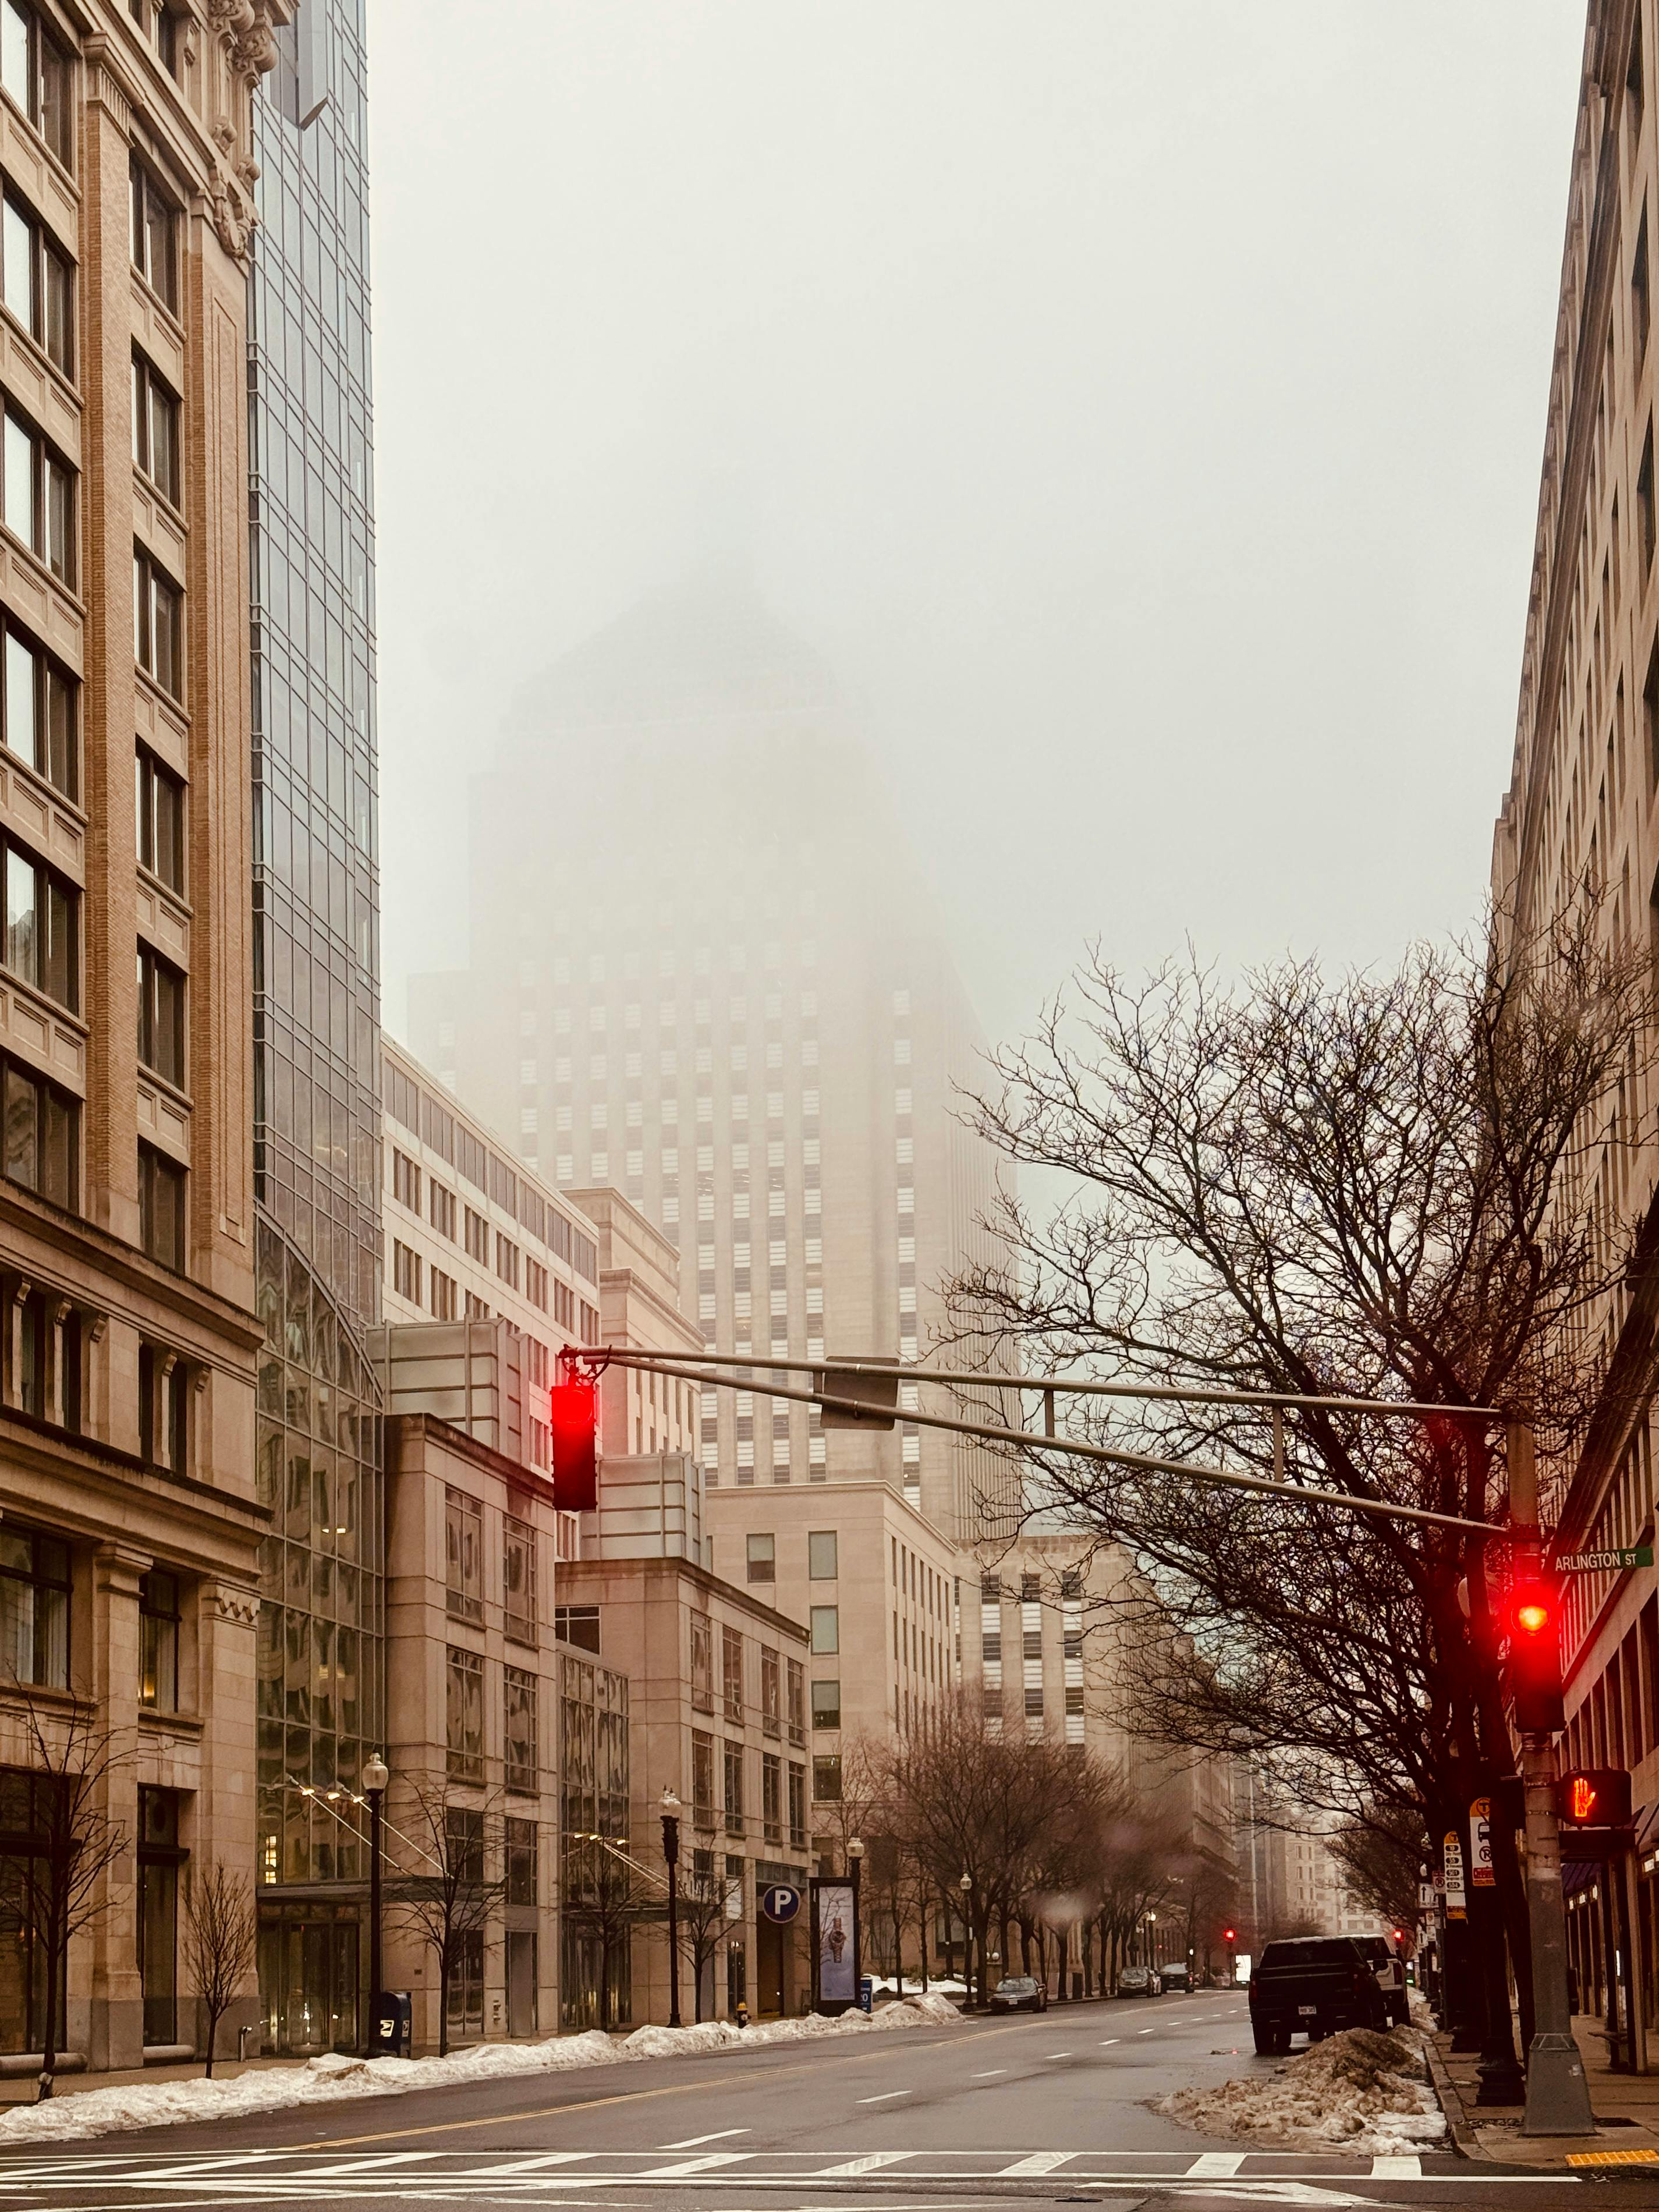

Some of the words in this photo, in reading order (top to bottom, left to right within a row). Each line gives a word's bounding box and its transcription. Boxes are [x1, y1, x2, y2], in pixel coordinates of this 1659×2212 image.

[1555, 1552, 1621, 1571] ARLINGTON
[1625, 1554, 1636, 1565] ST
[775, 1890, 792, 1915] P
